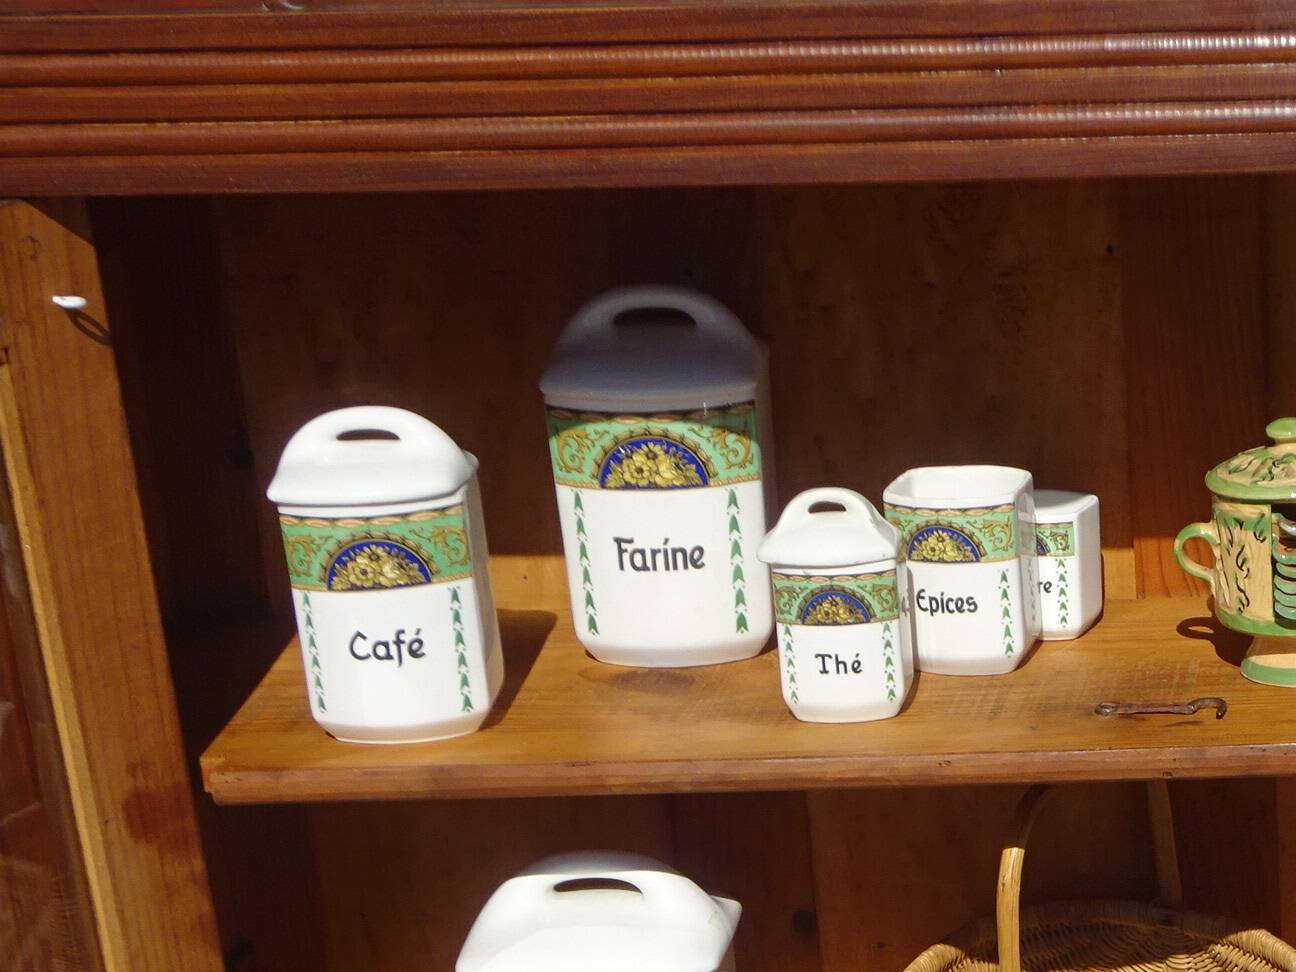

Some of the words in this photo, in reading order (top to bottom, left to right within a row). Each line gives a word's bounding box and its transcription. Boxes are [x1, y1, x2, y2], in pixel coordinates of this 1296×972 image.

[613, 536, 706, 572] Farine
[916, 588, 978, 616] Epices
[349, 627, 426, 668] Café
[814, 652, 863, 675] Thé
